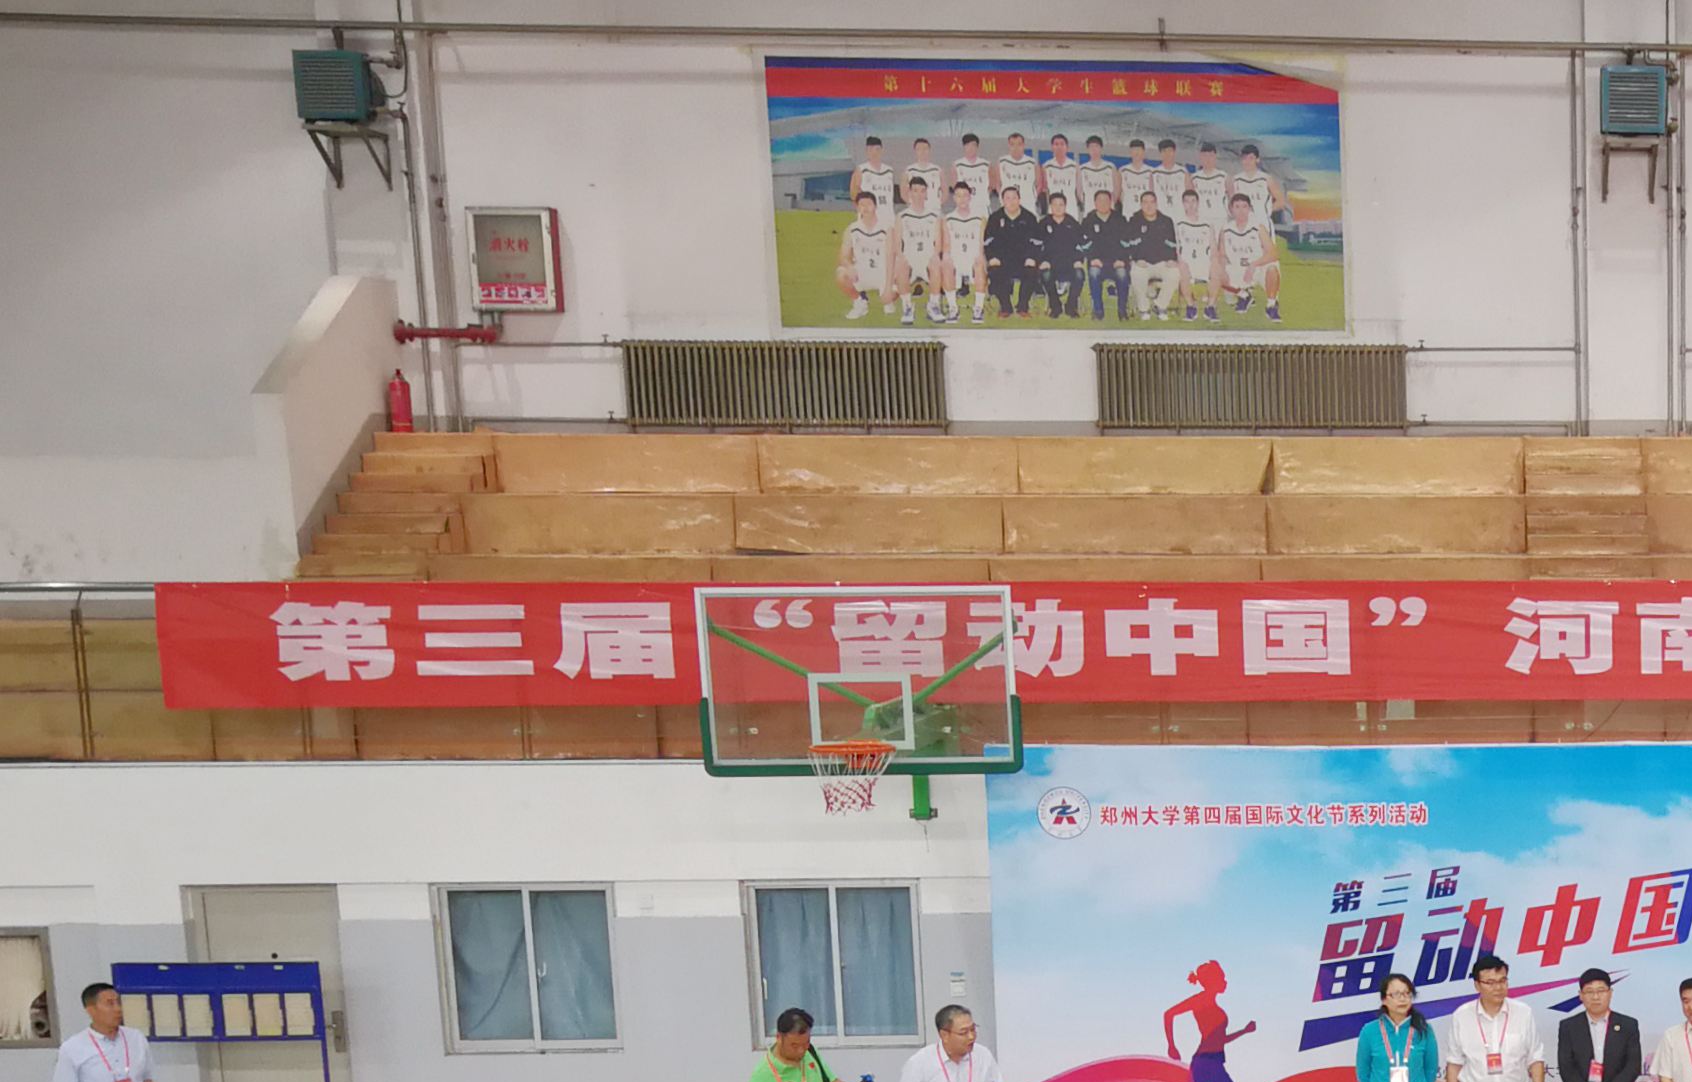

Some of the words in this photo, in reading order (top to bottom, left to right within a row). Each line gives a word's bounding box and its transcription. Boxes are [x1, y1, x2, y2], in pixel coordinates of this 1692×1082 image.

[884, 74, 1226, 97] 第十六届大学生篮球联赛
[1100, 801, 1429, 828] 郑州大学第四届国际文化节系列活动
[1330, 865, 1461, 914] 第三届
